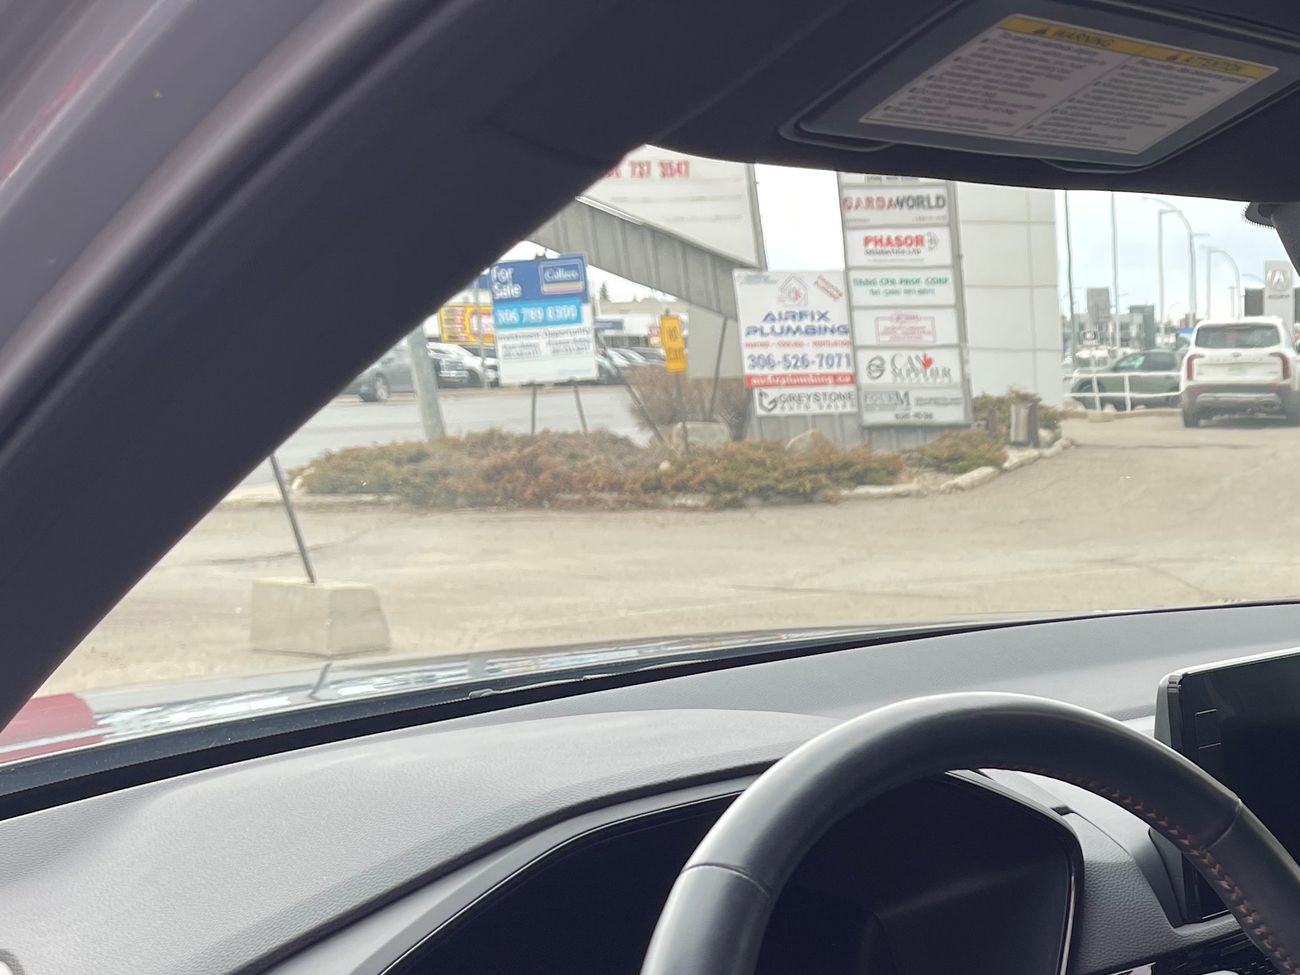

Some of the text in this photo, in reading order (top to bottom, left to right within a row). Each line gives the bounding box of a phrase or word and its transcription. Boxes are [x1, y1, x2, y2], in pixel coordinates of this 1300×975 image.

[841, 194, 946, 211] GARDAWORLD
[863, 235, 924, 248] PHASOR
[490, 265, 513, 283] For
[492, 281, 522, 299] Sale
[761, 310, 831, 322] AIRFIX
[745, 324, 850, 337] PLUMBING
[747, 353, 852, 370] 306-526-7071
[778, 391, 856, 403] GREYSTONE
